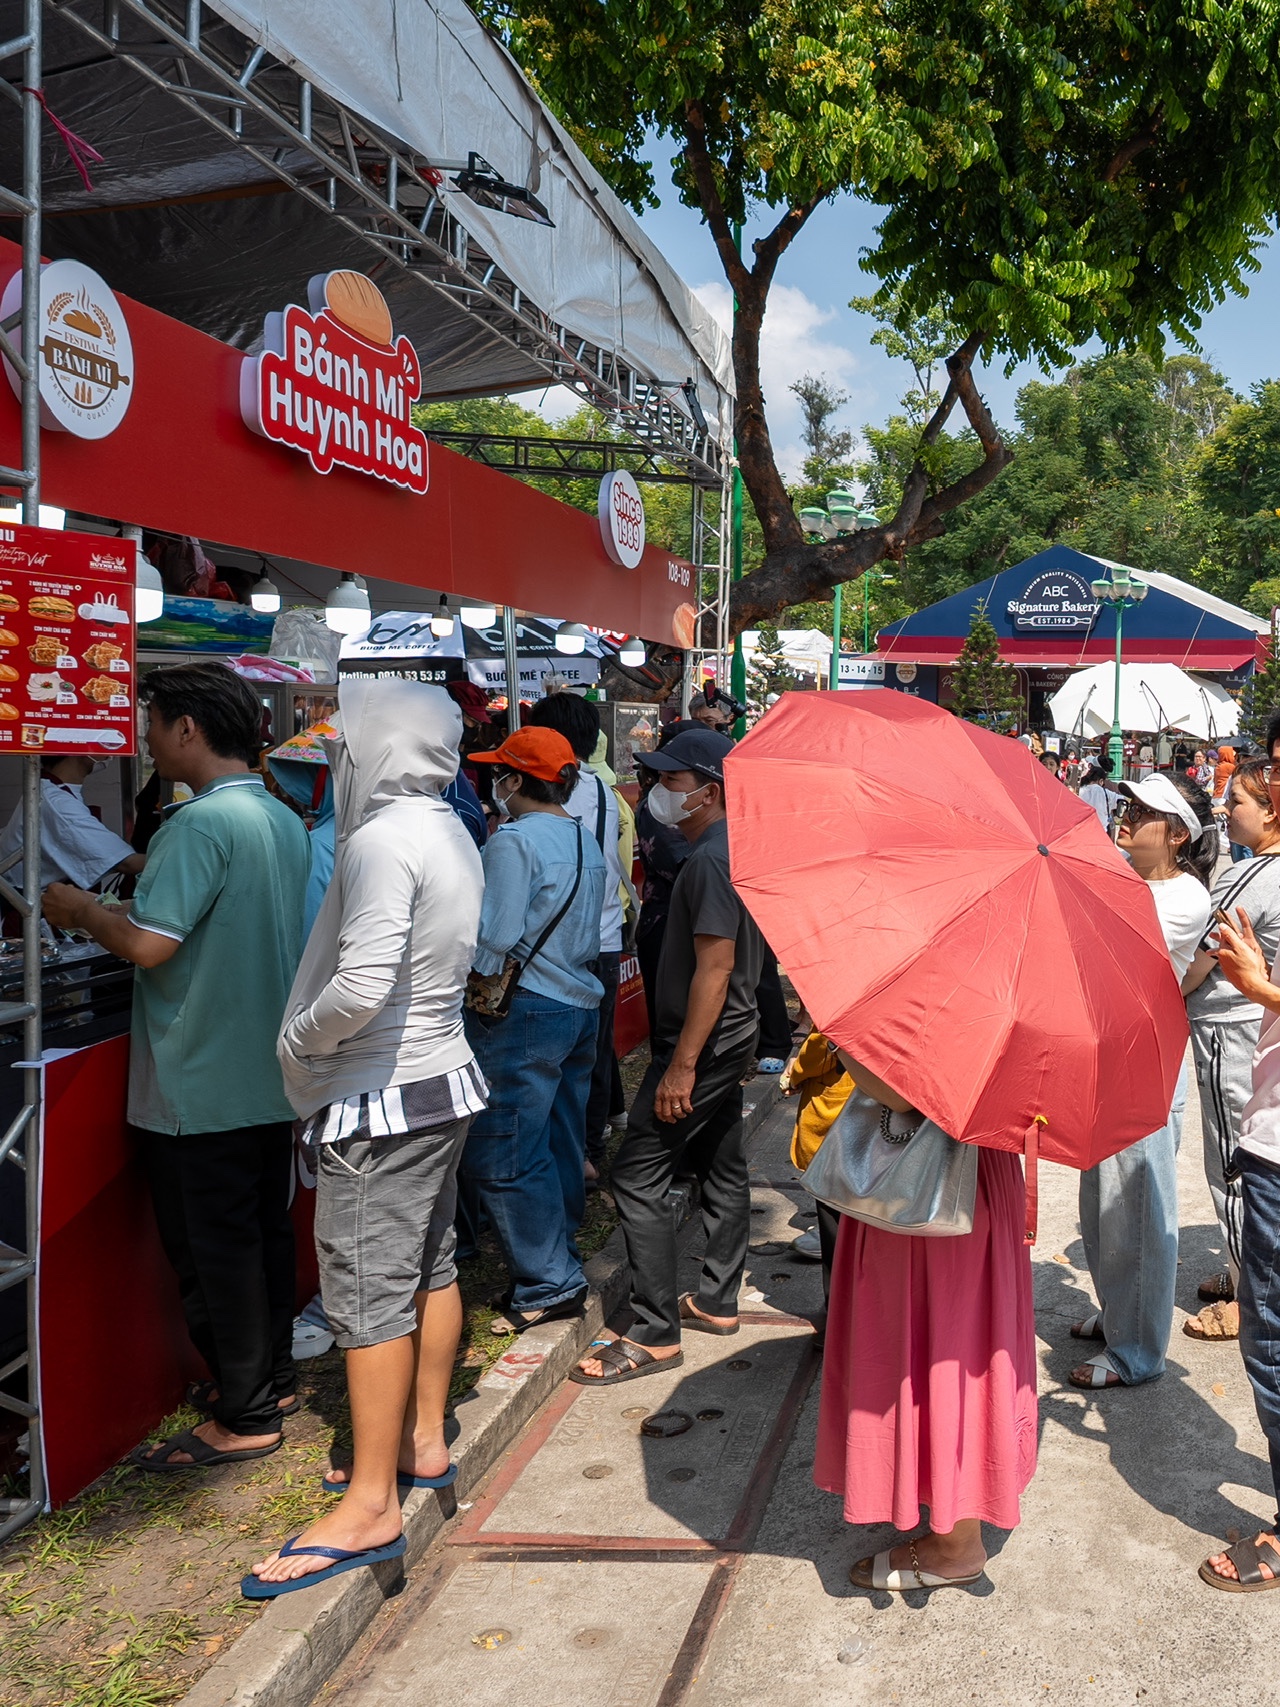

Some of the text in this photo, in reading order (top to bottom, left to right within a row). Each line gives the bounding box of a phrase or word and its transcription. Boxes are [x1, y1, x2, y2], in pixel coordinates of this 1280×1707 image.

[64, 331, 102, 354] FESTIVAL
[53, 348, 112, 384] BÁNH MÌ
[294, 324, 370, 405] Bánh
[49, 375, 116, 420] PREMIUM QUALITY
[270, 371, 423, 476] Huynh Hoa
[614, 482, 642, 524] Since
[617, 513, 640, 551] 1989
[668, 561, 690, 587] 108-109
[1023, 578, 1041, 599] PREMIUM
[1042, 585, 1069, 597] ABC
[1007, 600, 1101, 615] Signature Bakery
[339, 671, 376, 680] Hotline
[404, 671, 418, 680] 53
[420, 671, 433, 680] 53
[434, 671, 446, 680] 53
[840, 665, 850, 674] 13
[857, 665, 866, 674] 14
[873, 666, 883, 675] 15
